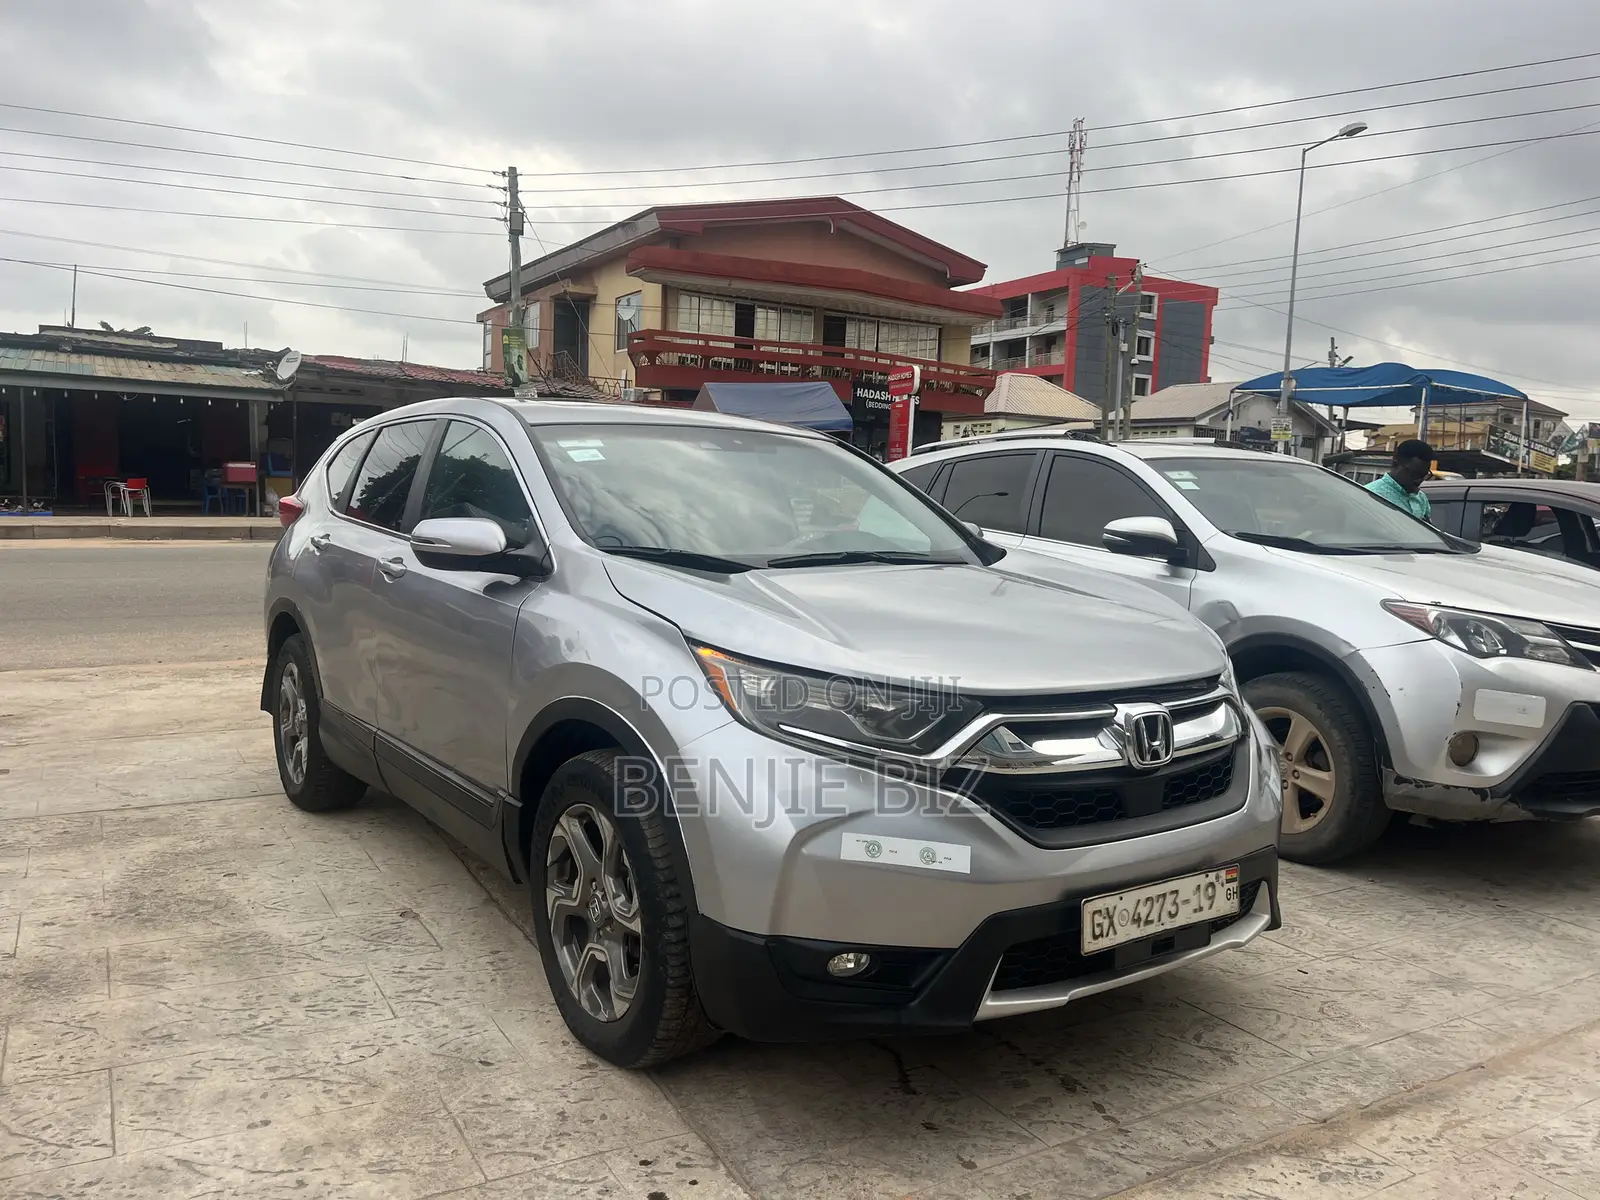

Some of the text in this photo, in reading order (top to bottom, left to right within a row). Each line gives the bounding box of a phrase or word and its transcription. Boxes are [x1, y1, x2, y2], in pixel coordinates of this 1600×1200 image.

[857, 388, 891, 402] HADASH
[1225, 885, 1238, 901] GH
[1091, 881, 1217, 941] GX 4273-19
